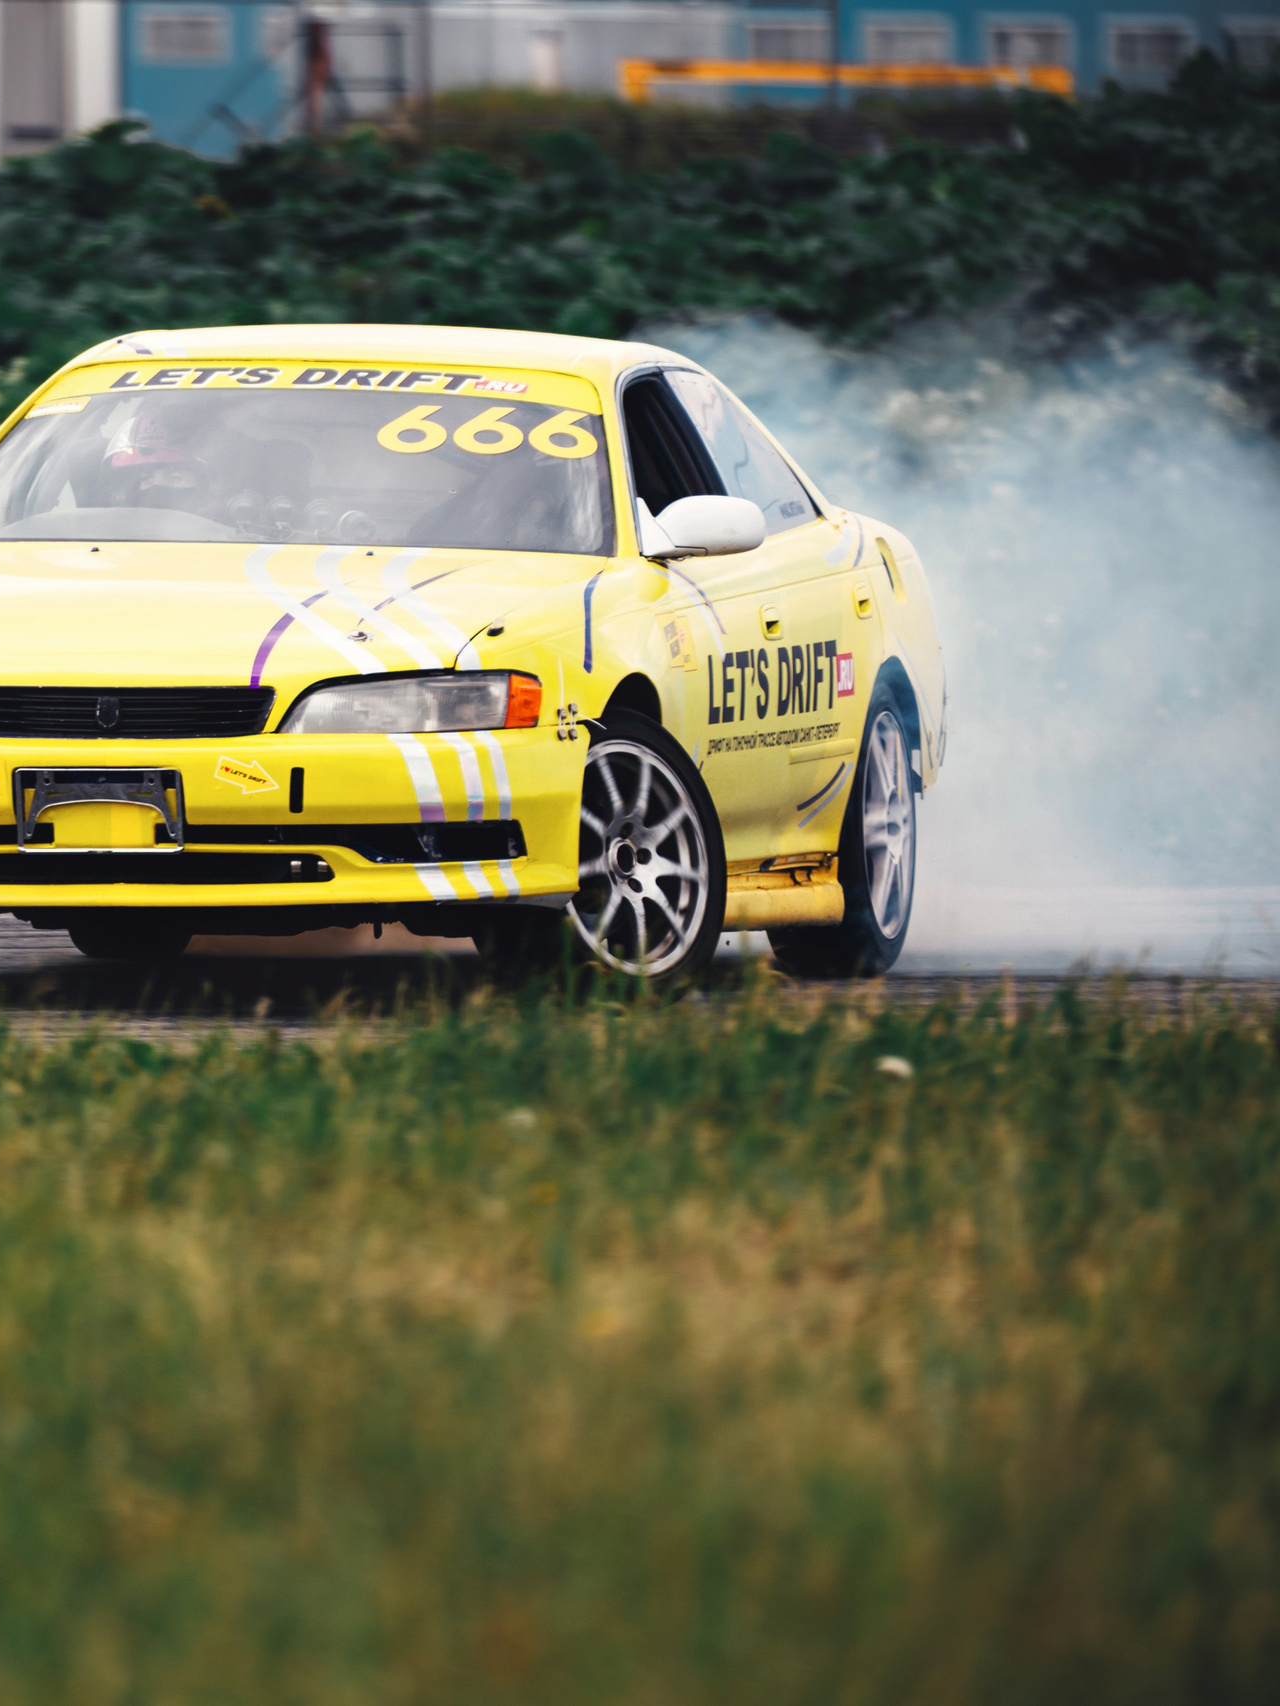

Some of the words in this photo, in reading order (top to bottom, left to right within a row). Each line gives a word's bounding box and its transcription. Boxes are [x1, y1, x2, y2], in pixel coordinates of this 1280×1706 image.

[110, 367, 279, 390] LET'S
[377, 405, 599, 460] 666
[708, 648, 769, 725] LET'S
